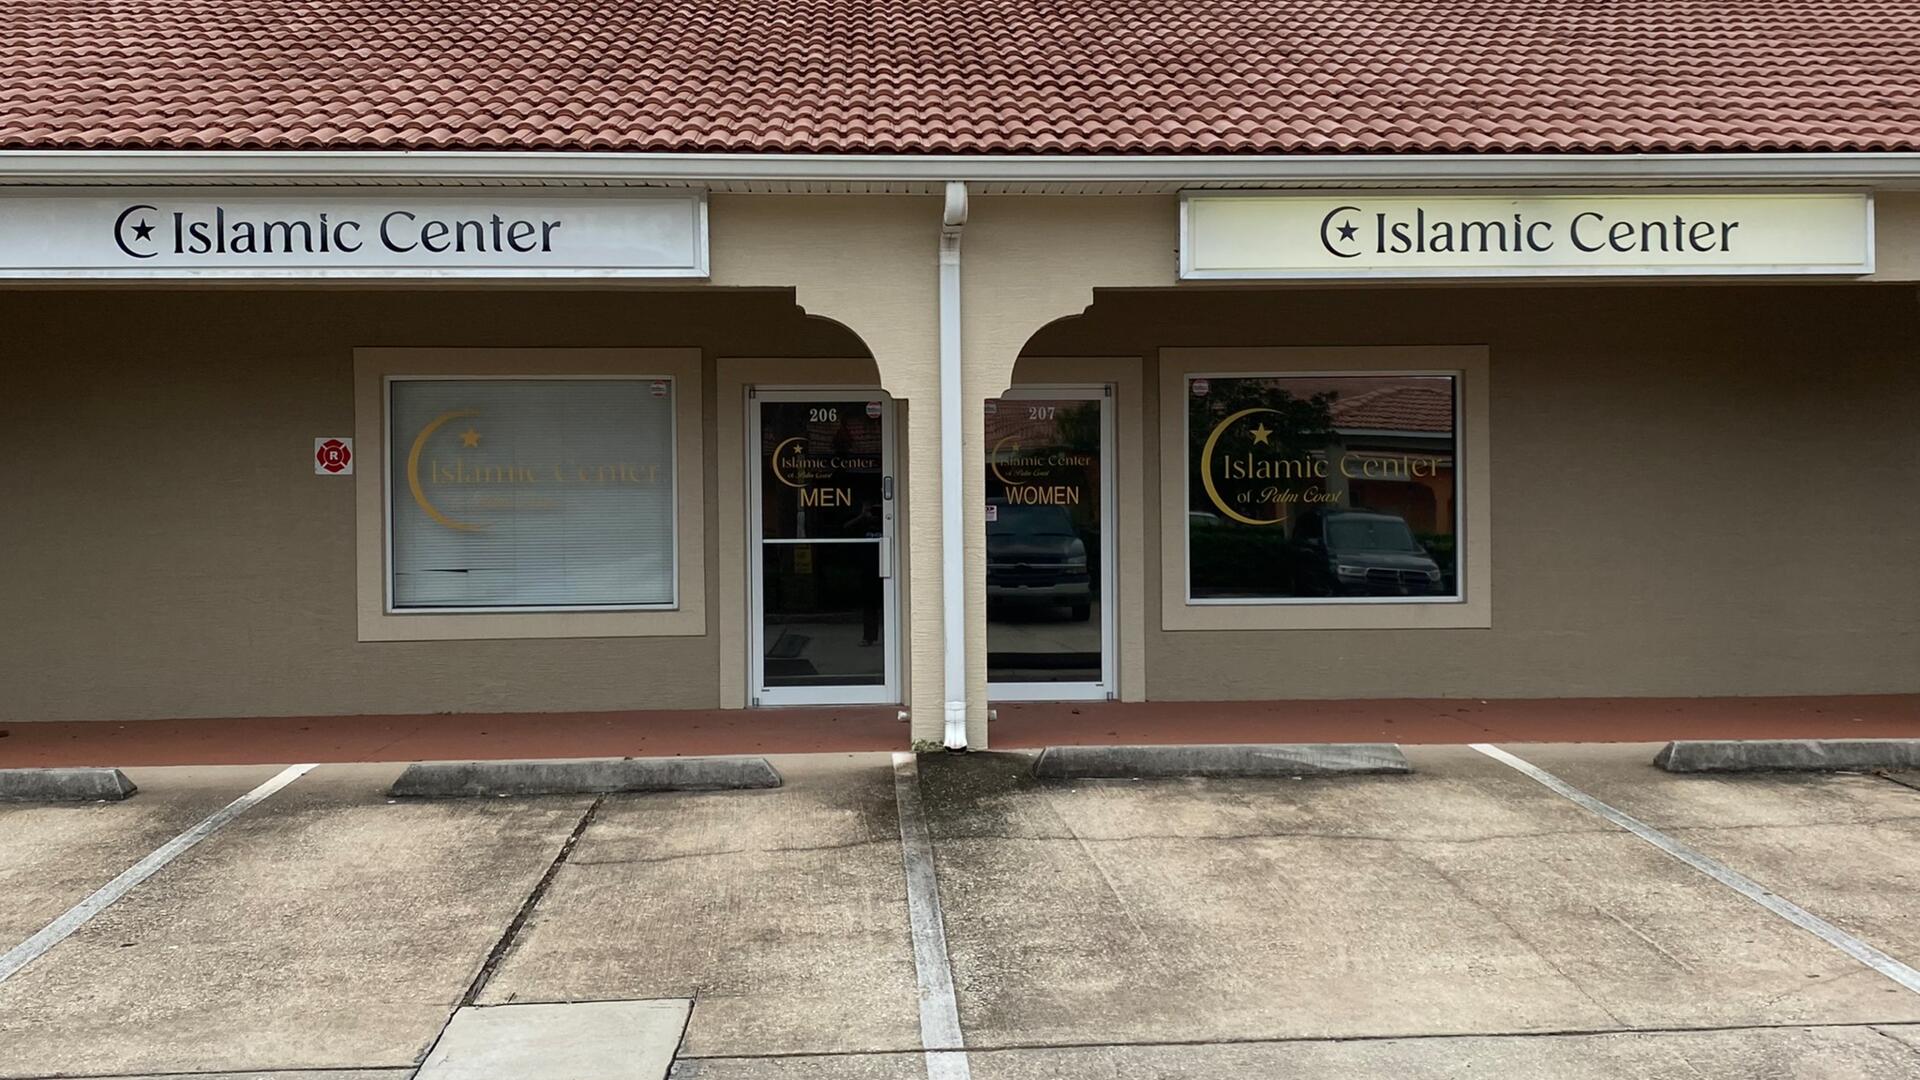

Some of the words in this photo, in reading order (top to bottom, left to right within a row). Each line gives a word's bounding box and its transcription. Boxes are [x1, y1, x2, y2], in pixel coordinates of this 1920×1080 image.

[173, 206, 363, 254] Islamic
[380, 211, 562, 254] Center
[1376, 208, 1555, 253] Islamic
[1569, 211, 1740, 253] Center
[809, 408, 838, 423] 206
[1028, 406, 1056, 420] 207
[329, 451, 339, 461] R
[782, 456, 828, 469] Islamic
[830, 457, 874, 469] Center
[1048, 455, 1092, 467] Center
[1224, 452, 1329, 480] Islamic
[1339, 455, 1442, 479] Center
[799, 488, 852, 507] MEN
[1005, 486, 1080, 505] WOMEN
[1236, 489, 1251, 504] of
[1257, 487, 1299, 504] Palm
[1302, 486, 1343, 504] Coast
